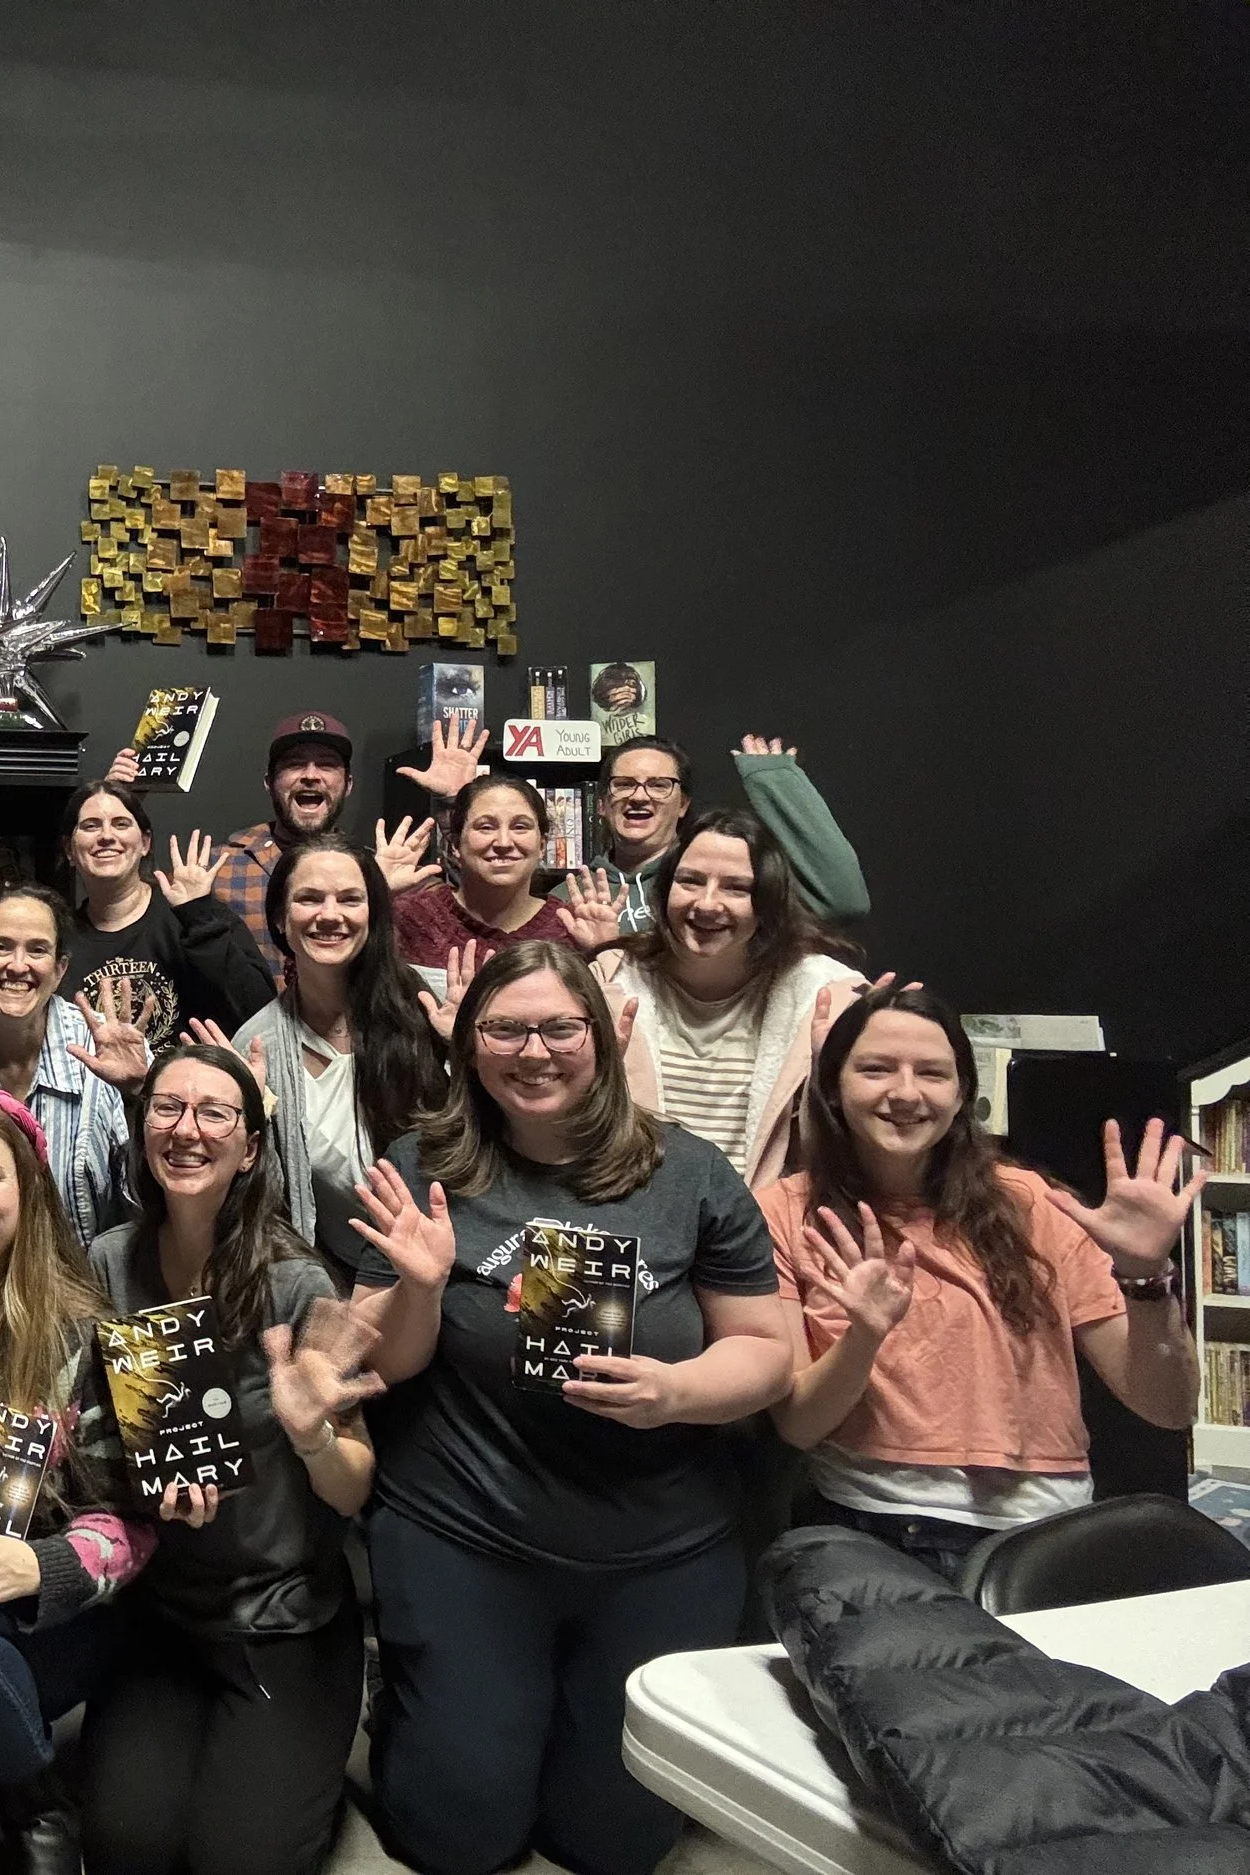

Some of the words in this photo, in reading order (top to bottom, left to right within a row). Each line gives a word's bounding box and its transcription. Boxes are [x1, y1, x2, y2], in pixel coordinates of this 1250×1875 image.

[150, 691, 204, 703] ANDY
[145, 705, 198, 716] WEIR
[443, 706, 479, 720] SHATTER
[505, 724, 545, 757] YA
[556, 729, 591, 743] YOUNG
[556, 746, 591, 757] ADULT
[137, 766, 177, 777] ARY
[84, 961, 158, 987] THIRTEEN
[532, 1230, 632, 1253] ANDY
[530, 1253, 631, 1280] WEIR
[637, 1258, 660, 1291] res
[108, 1310, 205, 1347] ANDY
[554, 1325, 599, 1337] PROJECT
[112, 1337, 215, 1374] WEIR
[159, 1421, 204, 1436] PROJECT
[135, 1433, 240, 1468] HAIL
[141, 1458, 243, 1496] MARY
